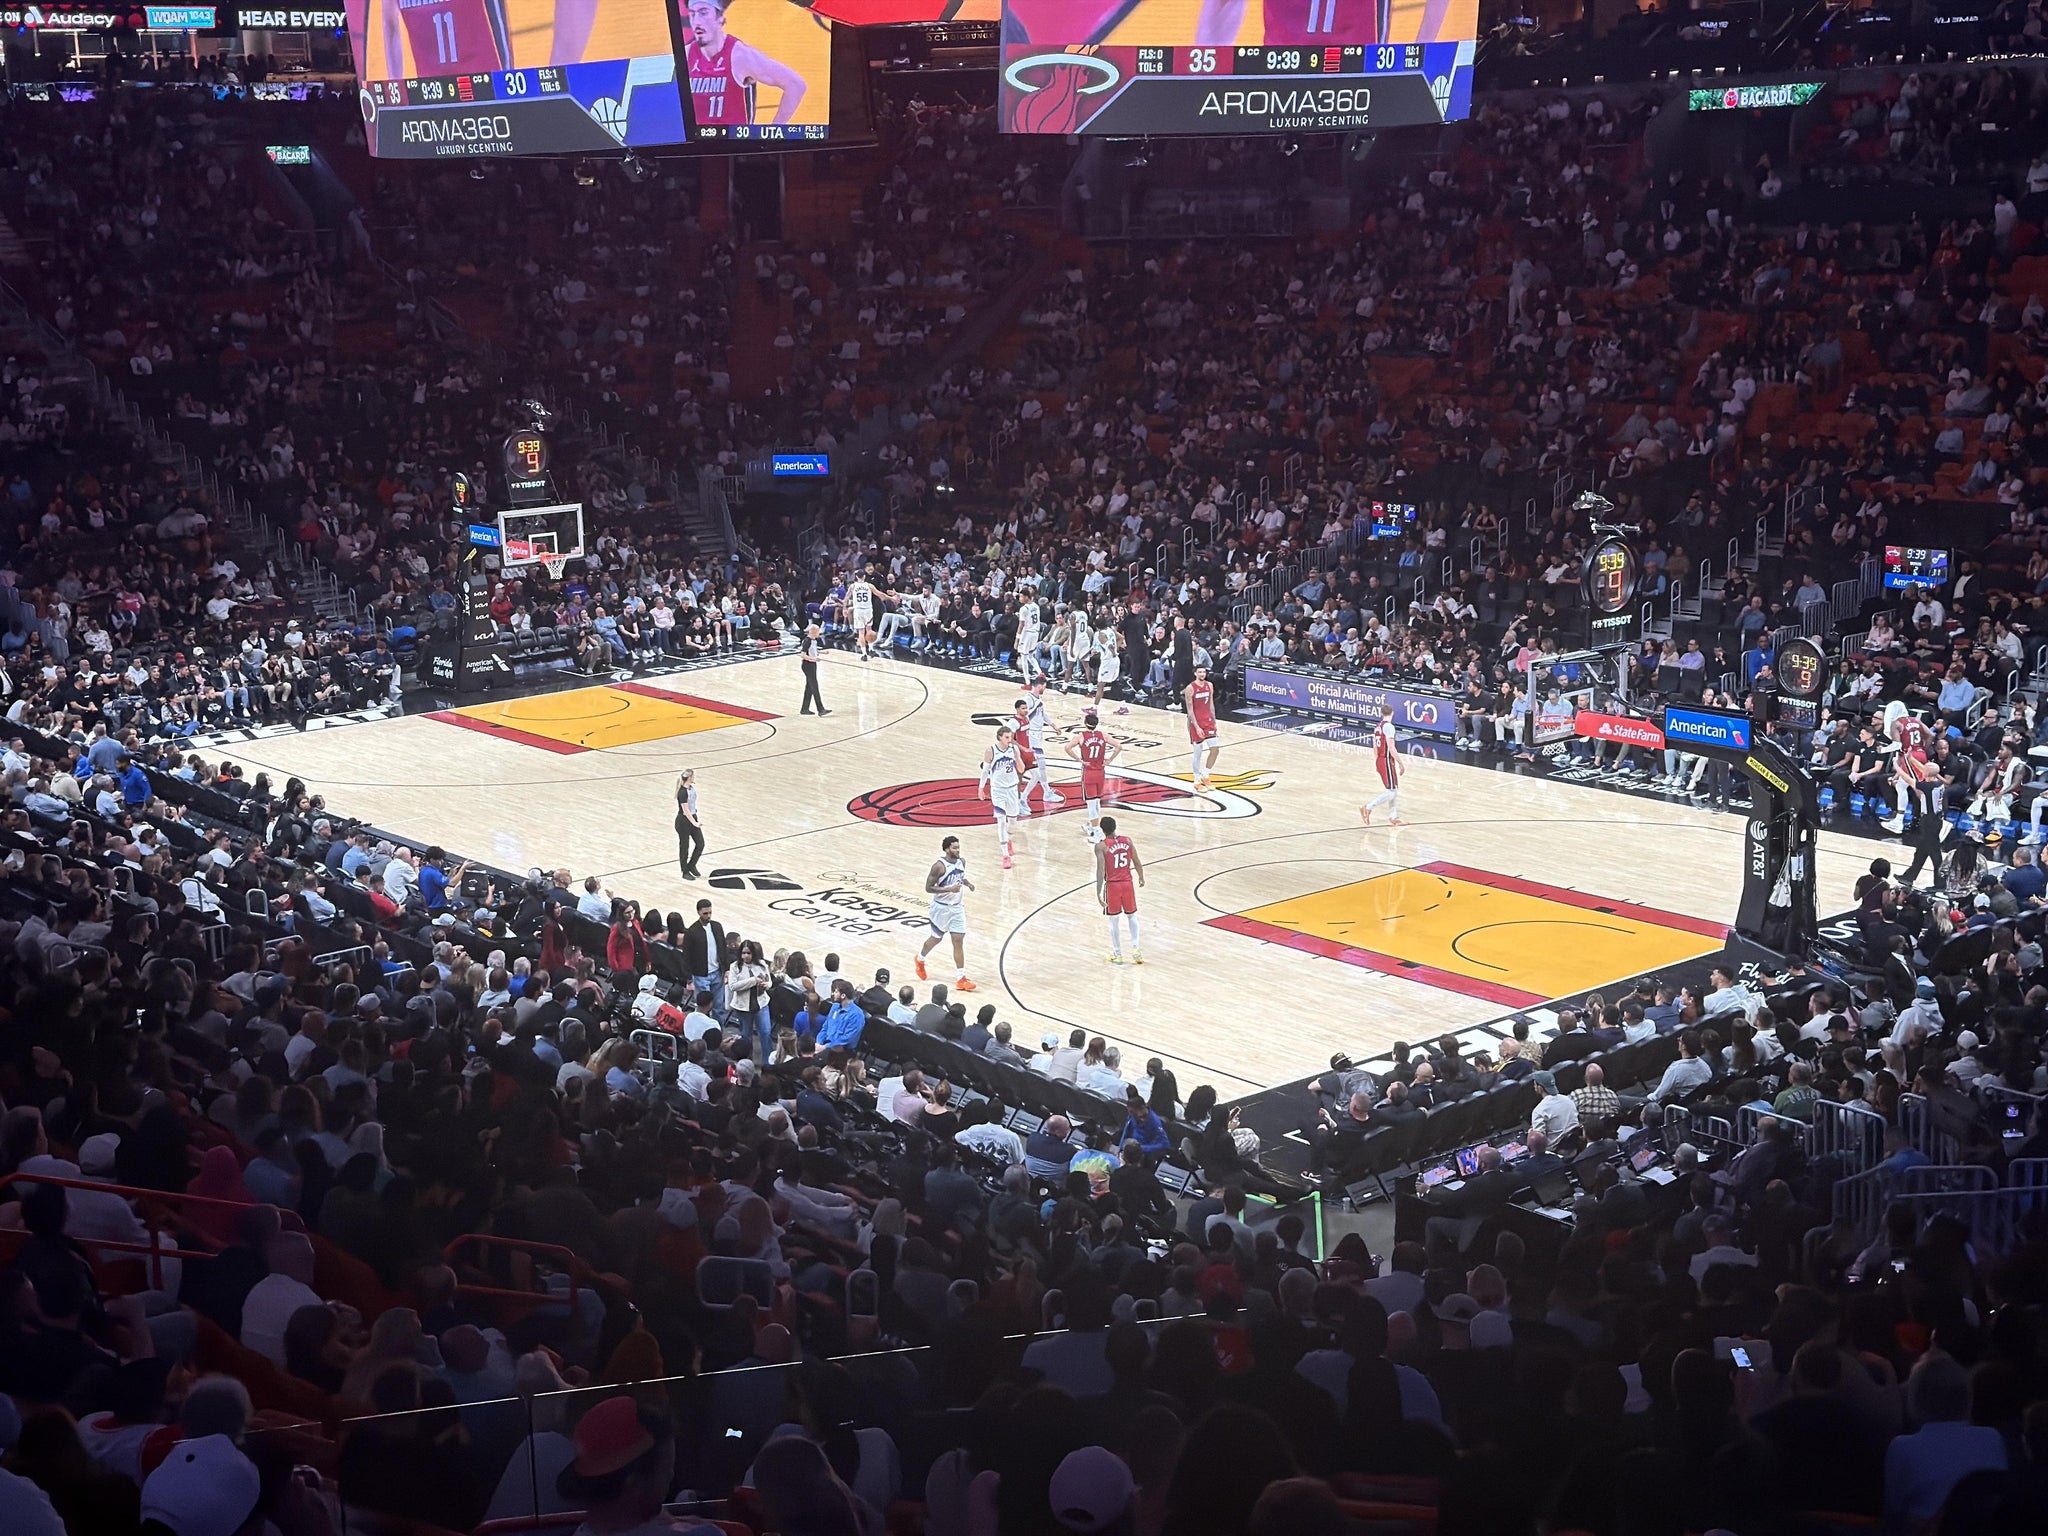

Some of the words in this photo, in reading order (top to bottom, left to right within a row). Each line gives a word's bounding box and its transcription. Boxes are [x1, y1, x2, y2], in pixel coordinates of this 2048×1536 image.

[4, 12, 21, 22] ON
[47, 12, 116, 28] Audacy
[153, 11, 188, 24] WQAM
[238, 11, 287, 26] HEAR
[290, 11, 346, 27] EVERY
[433, 11, 458, 63] 11
[1189, 49, 1217, 73] 35
[1266, 51, 1300, 70] 9:39
[1310, 53, 1319, 68] 9
[1376, 46, 1395, 69] 30
[421, 81, 443, 100] 9:39
[447, 83, 455, 97] 9
[505, 72, 527, 96] 30
[389, 82, 401, 104] 35
[708, 96, 724, 118] 11
[1199, 88, 1371, 116] AROMA360
[402, 115, 511, 143] AROMA360
[1269, 116, 1315, 128] LUXURY
[1318, 114, 1369, 126] SCENTING
[700, 128, 717, 137] 9:39
[736, 126, 750, 138] 30
[760, 126, 785, 139] UTA
[435, 145, 465, 155] LUXURY
[467, 142, 513, 154] SCENTING
[517, 440, 541, 454] 9:39
[527, 452, 540, 473] 9
[775, 461, 814, 470] American
[520, 480, 546, 488] TISSOT
[471, 530, 492, 541] American
[1600, 552, 1624, 572] 9:39
[1907, 548, 1927, 560] 9:39
[1892, 565, 1901, 573] 35
[1609, 571, 1622, 603] 9
[856, 592, 869, 602] 55
[1079, 621, 1085, 633] 0
[1602, 614, 1633, 628] TISSOT
[466, 659, 494, 668] American
[1791, 654, 1817, 671] 9:39
[1801, 670, 1811, 689] 9
[1251, 681, 1287, 696] American
[1308, 682, 1341, 698] Official
[1343, 688, 1374, 704] Airline
[1374, 693, 1386, 705] of
[1311, 696, 1326, 708] the
[1327, 699, 1357, 714] Miami
[1358, 704, 1383, 718] HEAT
[1788, 697, 1818, 709] TISSOT
[1670, 718, 1727, 739] American
[1910, 730, 1921, 745] 13
[1089, 745, 1100, 758] 11
[1114, 852, 1127, 869] 15
[1752, 841, 1765, 880] AT&T
[805, 887, 933, 929] Kaseya
[767, 898, 894, 936] Center
